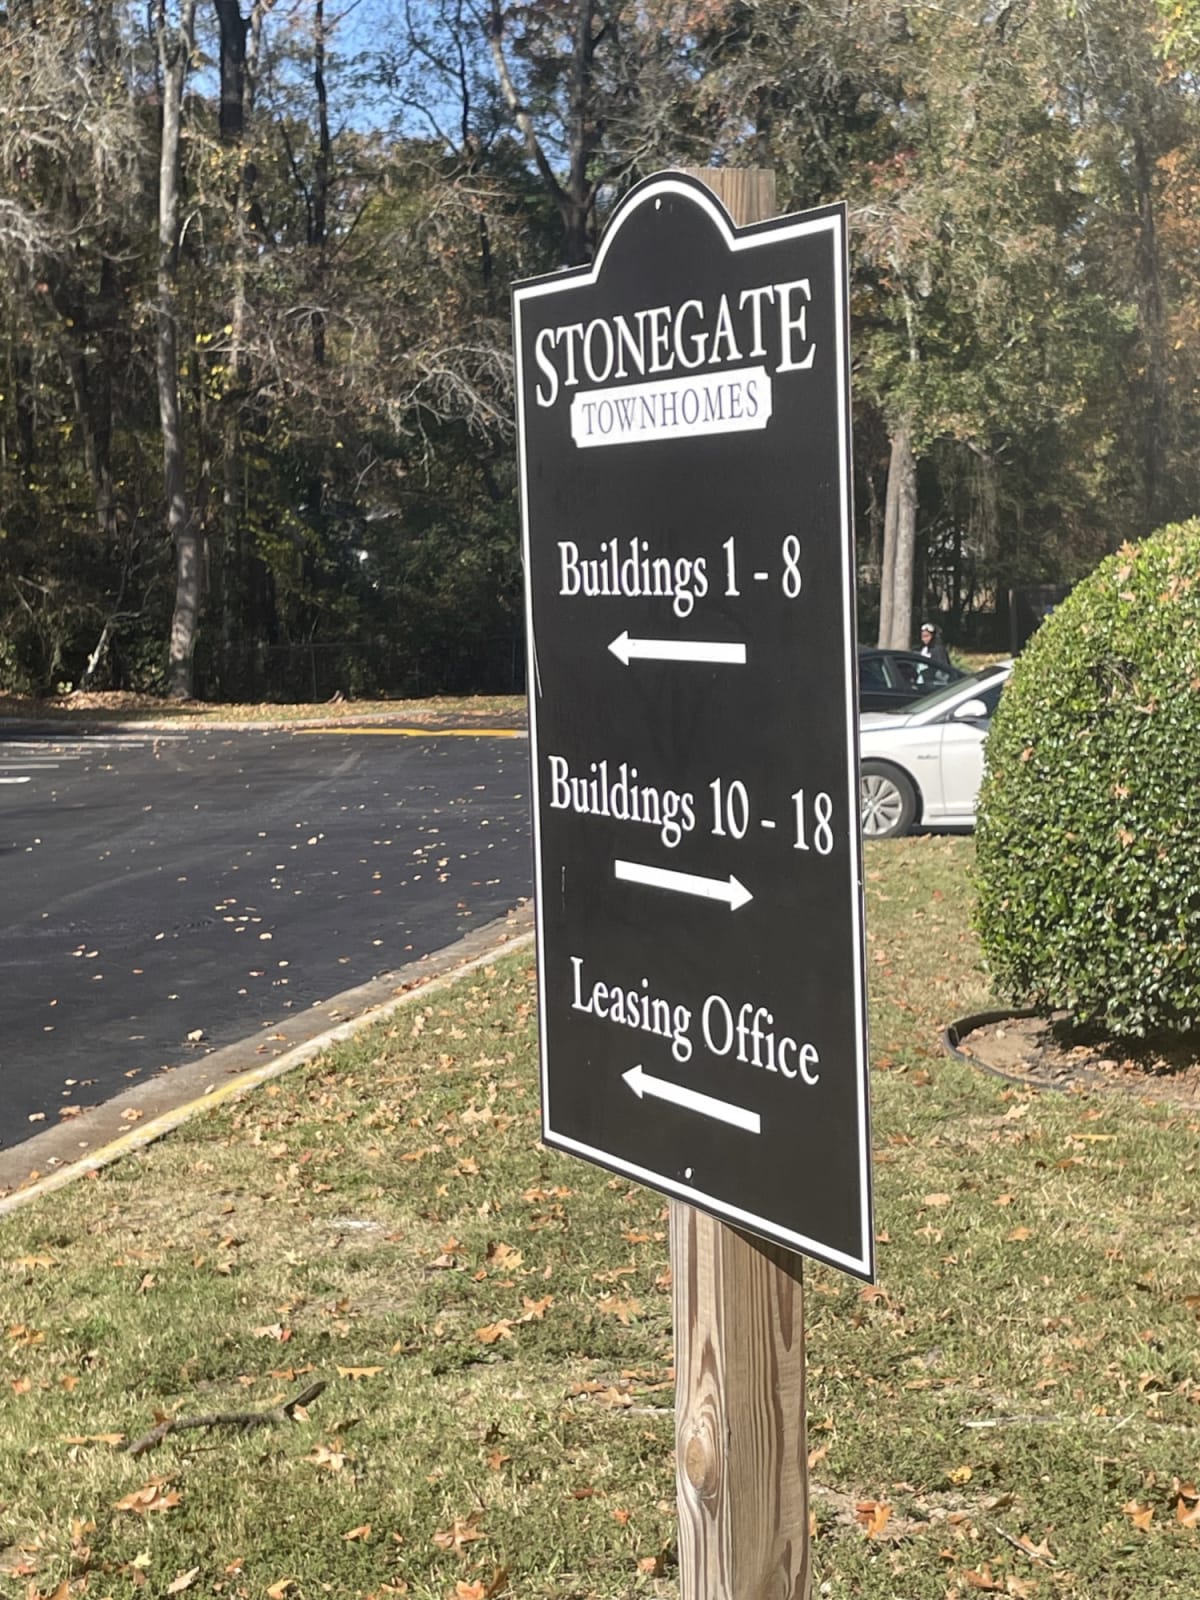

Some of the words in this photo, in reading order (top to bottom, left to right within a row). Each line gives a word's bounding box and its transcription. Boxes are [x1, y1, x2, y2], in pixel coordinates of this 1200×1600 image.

[534, 278, 817, 408] STONEGATE
[581, 380, 760, 436] TOWNHOMES
[557, 536, 709, 618] Buildings
[722, 536, 741, 597] 1
[753, 572, 769, 581] -
[782, 534, 802, 599] 8
[547, 755, 696, 849] Buildings
[709, 777, 749, 840] 10
[760, 819, 776, 829] -
[791, 788, 834, 856] 18
[570, 956, 693, 1063] Leasing
[701, 995, 820, 1086] Office
